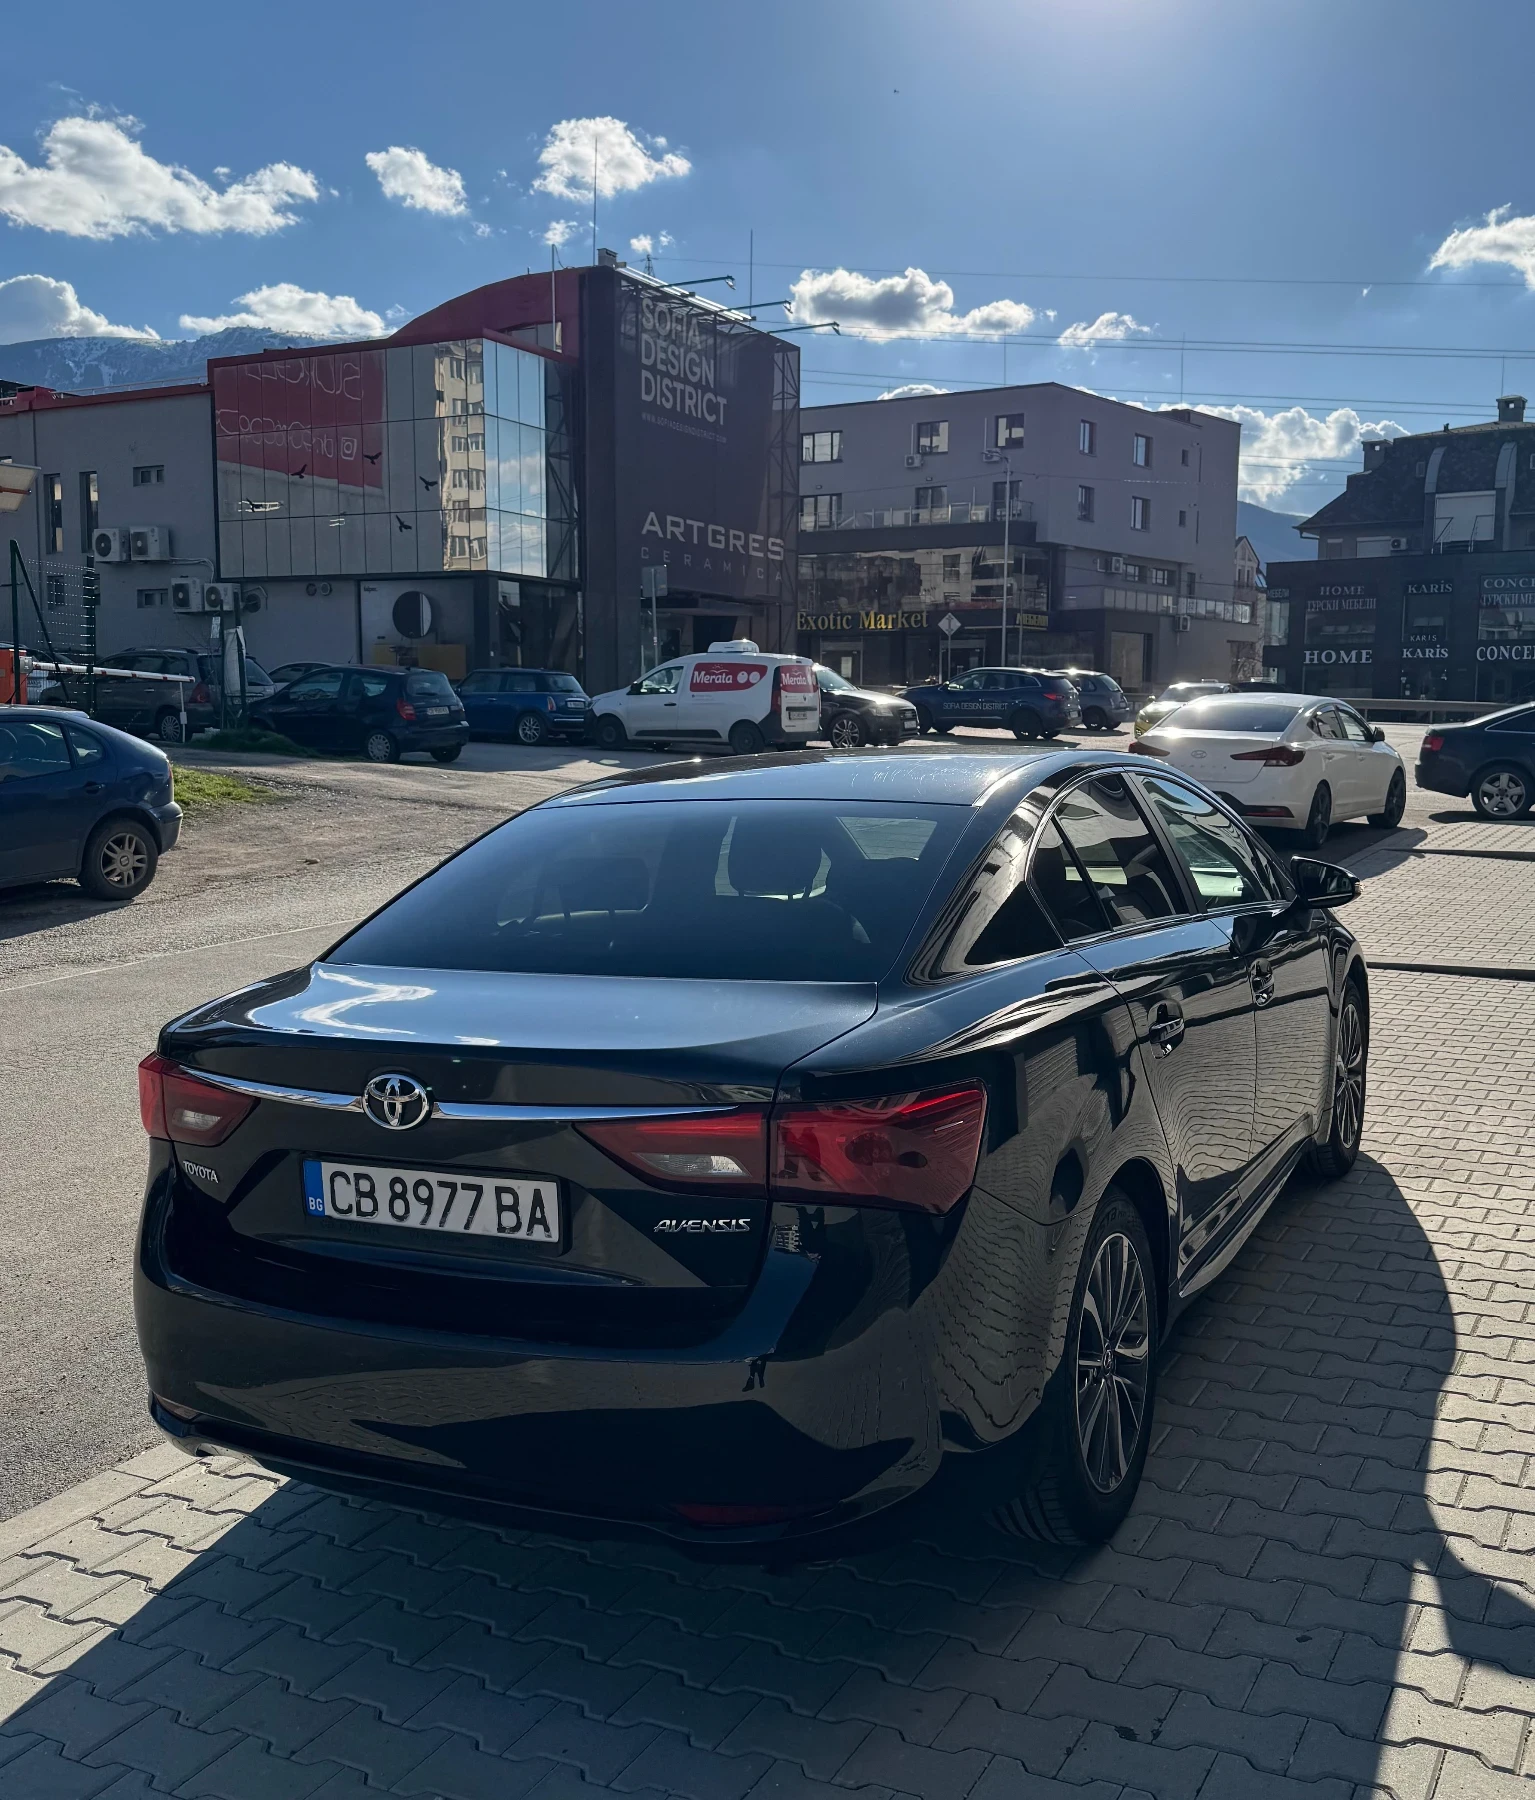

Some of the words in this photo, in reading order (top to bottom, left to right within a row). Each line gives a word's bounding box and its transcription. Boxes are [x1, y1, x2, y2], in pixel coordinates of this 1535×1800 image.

[641, 297, 701, 350] SOFIA
[641, 333, 715, 388] DESIGN
[641, 369, 727, 426] DISTRICT
[641, 511, 785, 561] ARTGRES
[641, 546, 782, 582] CERAMICA
[1320, 586, 1365, 596] HOME
[1307, 600, 1339, 612] ТУРСКИ
[1341, 598, 1377, 611] МЕБЕЛИ
[797, 610, 852, 631] Exotic
[859, 609, 929, 630] Market
[1303, 650, 1373, 664] HOME
[1476, 645, 1535, 661] CONCE
[693, 671, 733, 684] Merata
[781, 673, 807, 686] Merata
[943, 702, 960, 710] SOFIA
[961, 702, 982, 710] DESIGN
[982, 702, 1007, 710] DISTRICT
[183, 1160, 219, 1184] TOYOTA
[308, 1196, 324, 1212] BG
[329, 1170, 379, 1219] CB
[388, 1176, 484, 1231] 8977
[494, 1185, 553, 1239] BA
[653, 1218, 751, 1233] AVENSIS
